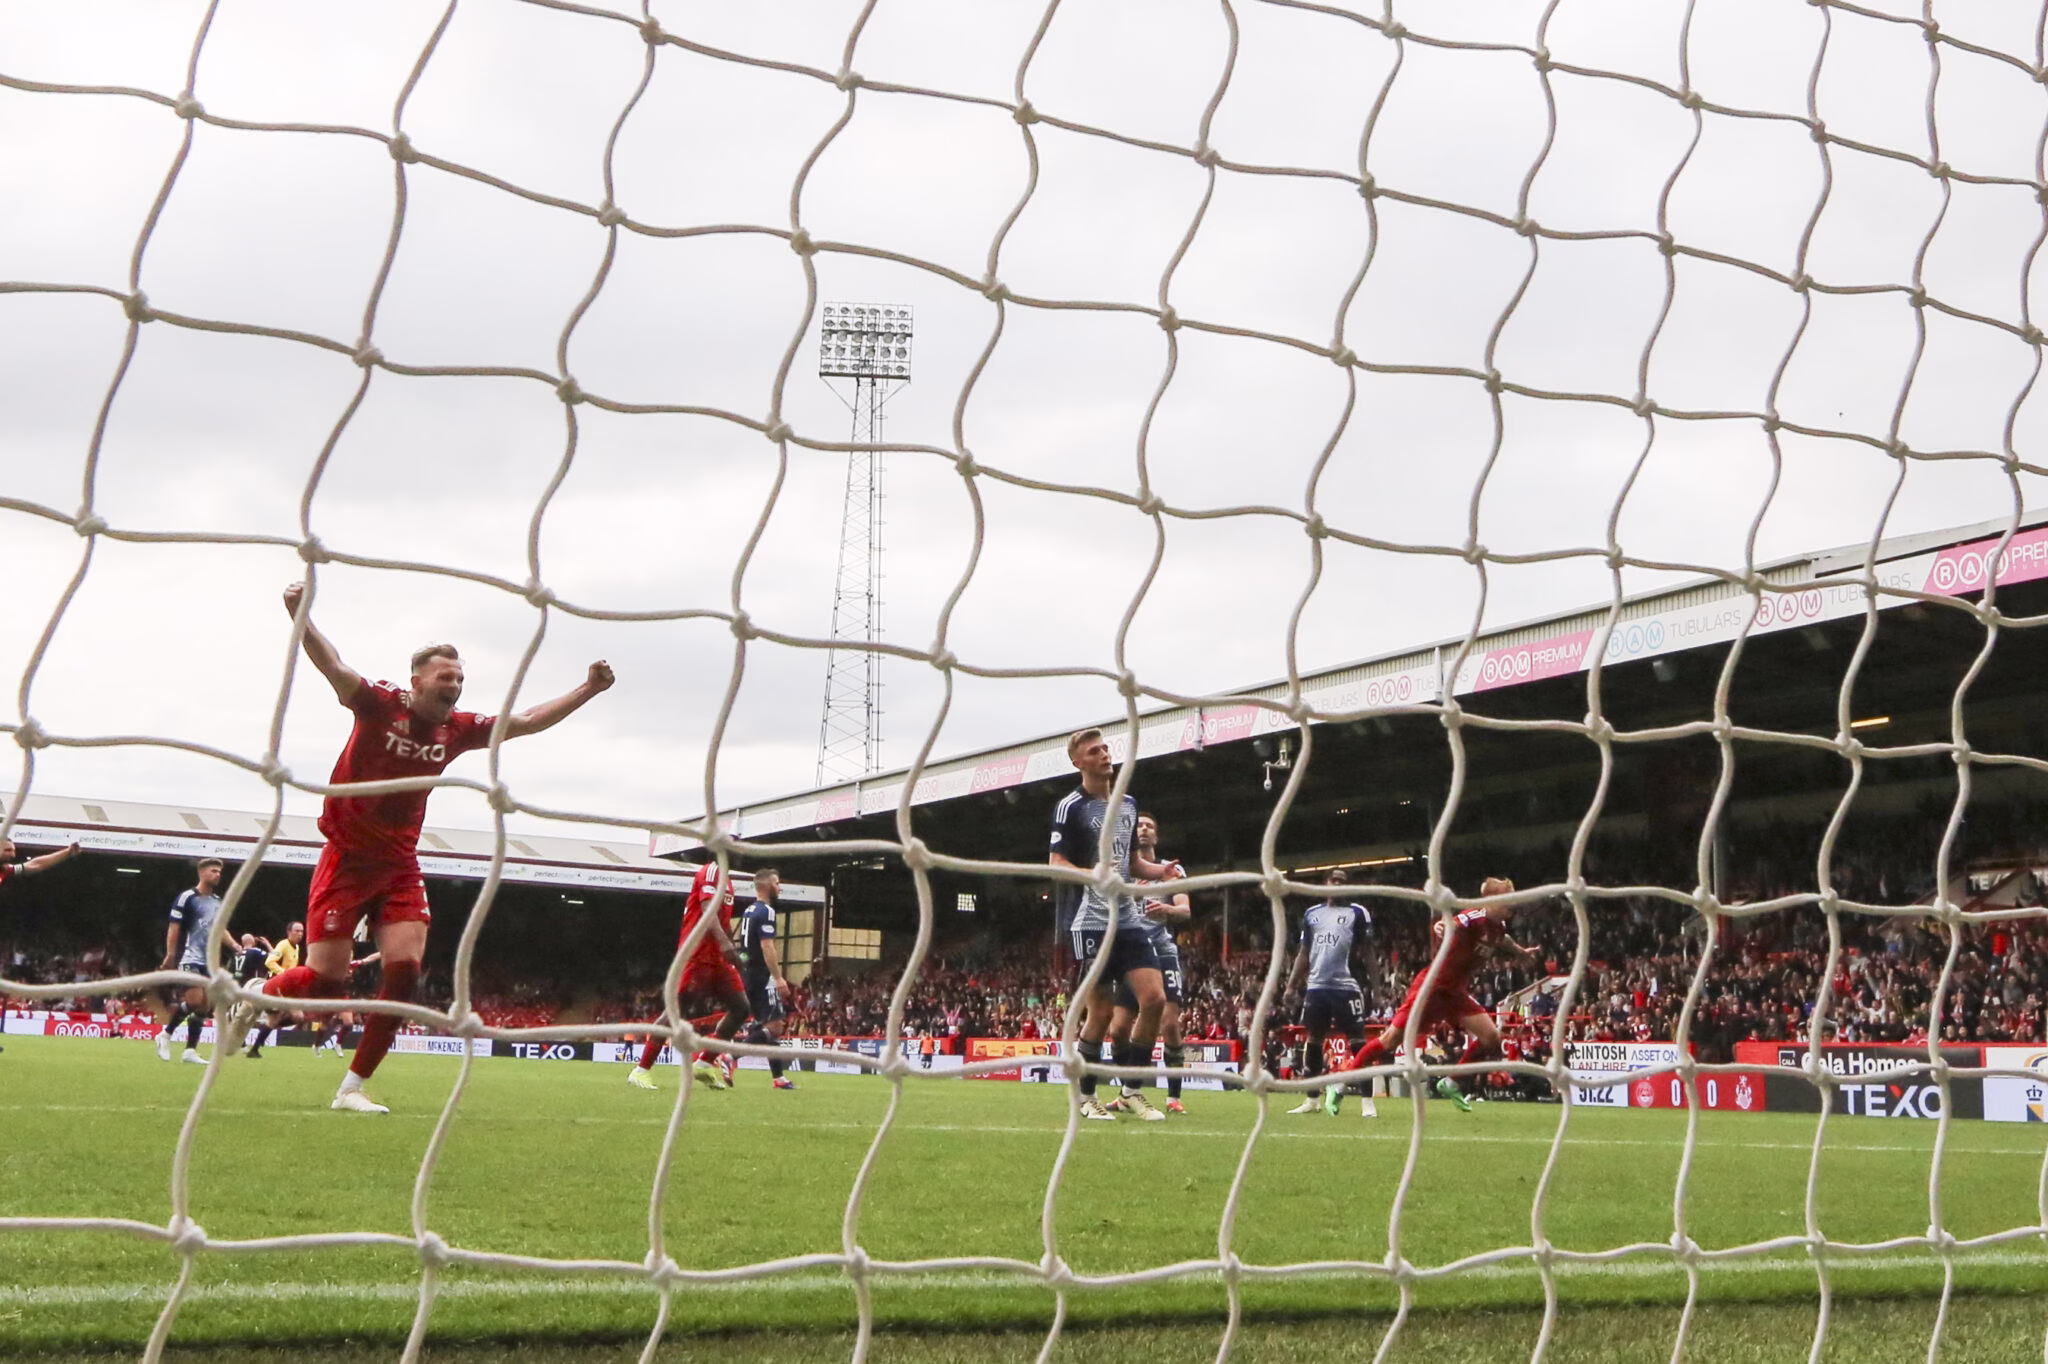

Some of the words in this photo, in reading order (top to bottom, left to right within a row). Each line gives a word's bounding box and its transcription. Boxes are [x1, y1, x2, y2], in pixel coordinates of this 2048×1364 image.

[1755, 587, 1823, 626] RAM
[1829, 572, 1912, 604] TUBARS
[1606, 620, 1665, 657] RAM
[1670, 609, 1742, 638] TUBULARS
[1482, 651, 1531, 683] RAM
[1532, 642, 1582, 665] PREMIUM
[1366, 675, 1412, 706] RAM
[385, 731, 446, 762] TEXO
[1112, 837, 1130, 860] ity
[1316, 931, 1341, 947] city
[234, 955, 247, 972] 17
[1348, 999, 1363, 1016] 19
[55, 1022, 101, 1038] RAM
[102, 1027, 153, 1040] TULARS
[511, 1043, 576, 1061] TEXO
[1565, 1044, 1627, 1061] cINTOSH
[1631, 1049, 1661, 1062] ASSET
[1570, 1060, 1599, 1072] LANT
[1670, 1078, 1681, 1107] 0
[1707, 1079, 1718, 1108] 0
[1839, 1084, 1944, 1119] TEXO
